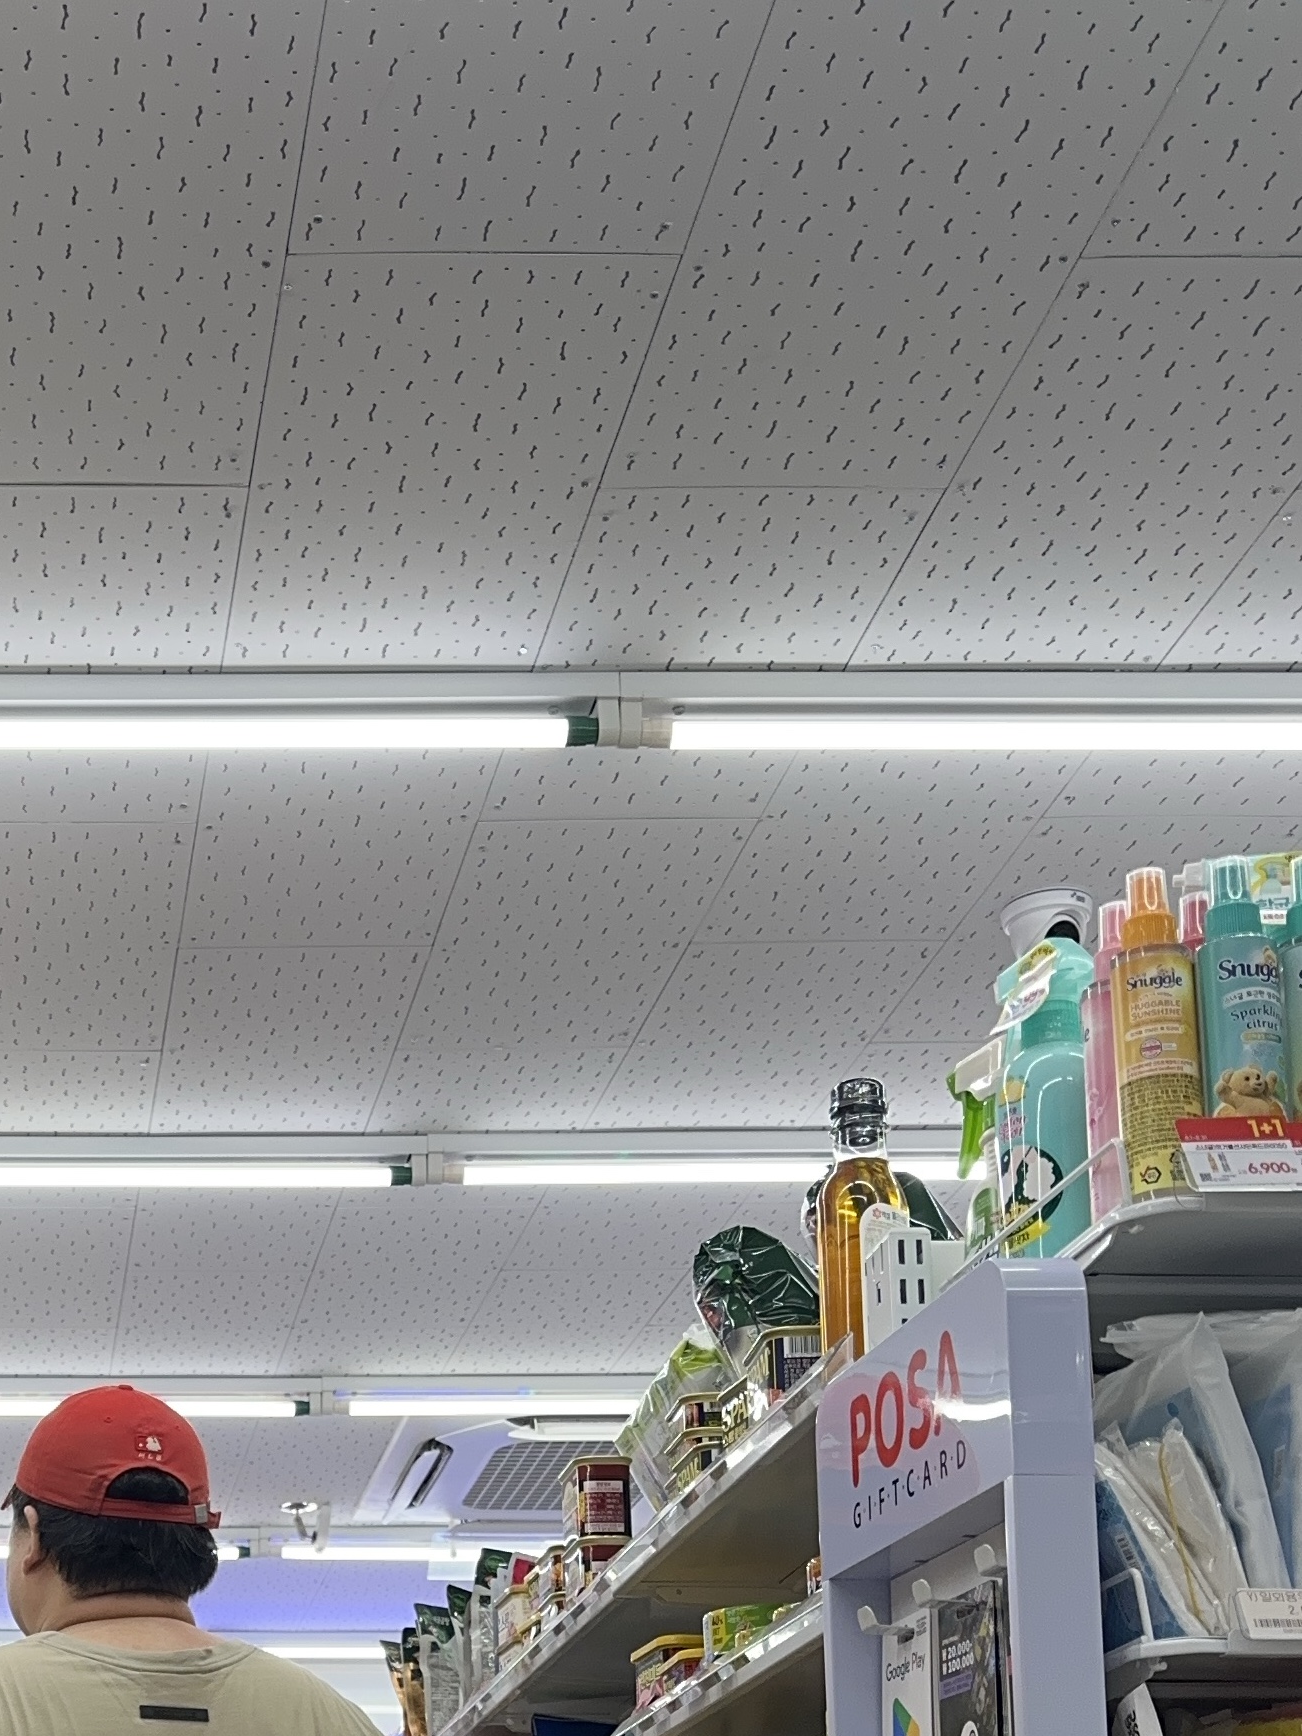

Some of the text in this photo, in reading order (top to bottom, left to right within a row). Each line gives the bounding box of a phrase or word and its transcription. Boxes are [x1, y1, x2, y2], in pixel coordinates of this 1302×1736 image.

[1126, 964, 1183, 993] Snuggle
[1247, 1119, 1284, 1138] 1+1
[886, 1651, 926, 1682] Google Play
